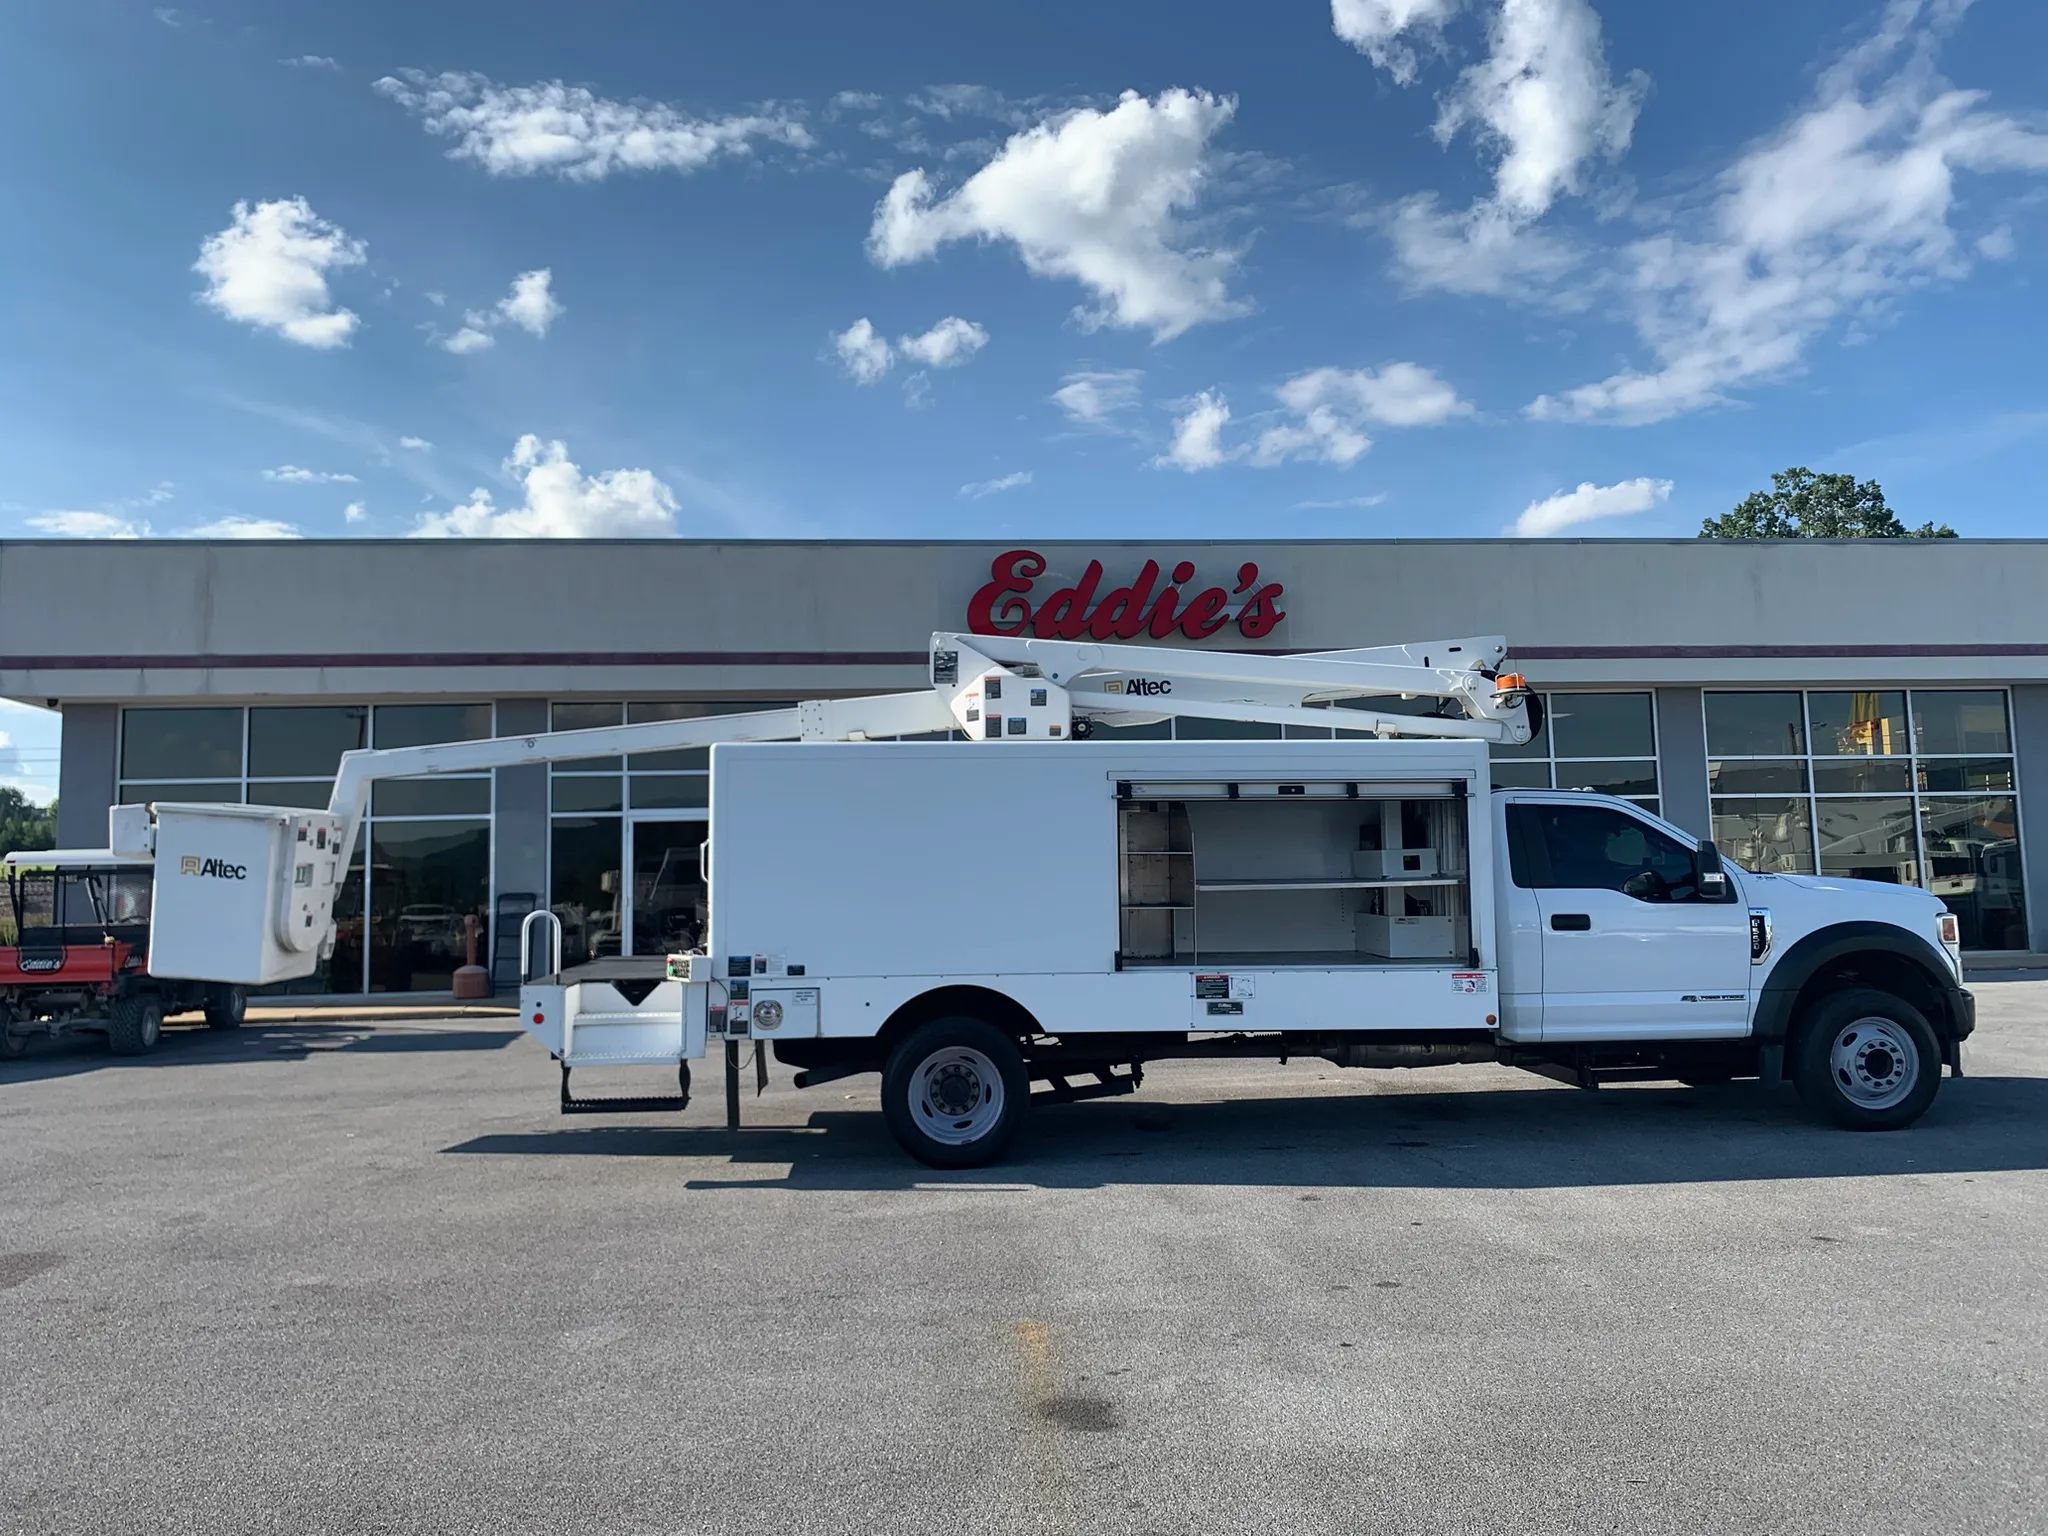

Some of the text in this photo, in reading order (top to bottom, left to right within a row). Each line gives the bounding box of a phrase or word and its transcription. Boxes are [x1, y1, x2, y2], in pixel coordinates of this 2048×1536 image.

[967, 550, 1286, 640] Eddie's
[1126, 678, 1172, 696] Altec
[201, 858, 247, 880] Altec
